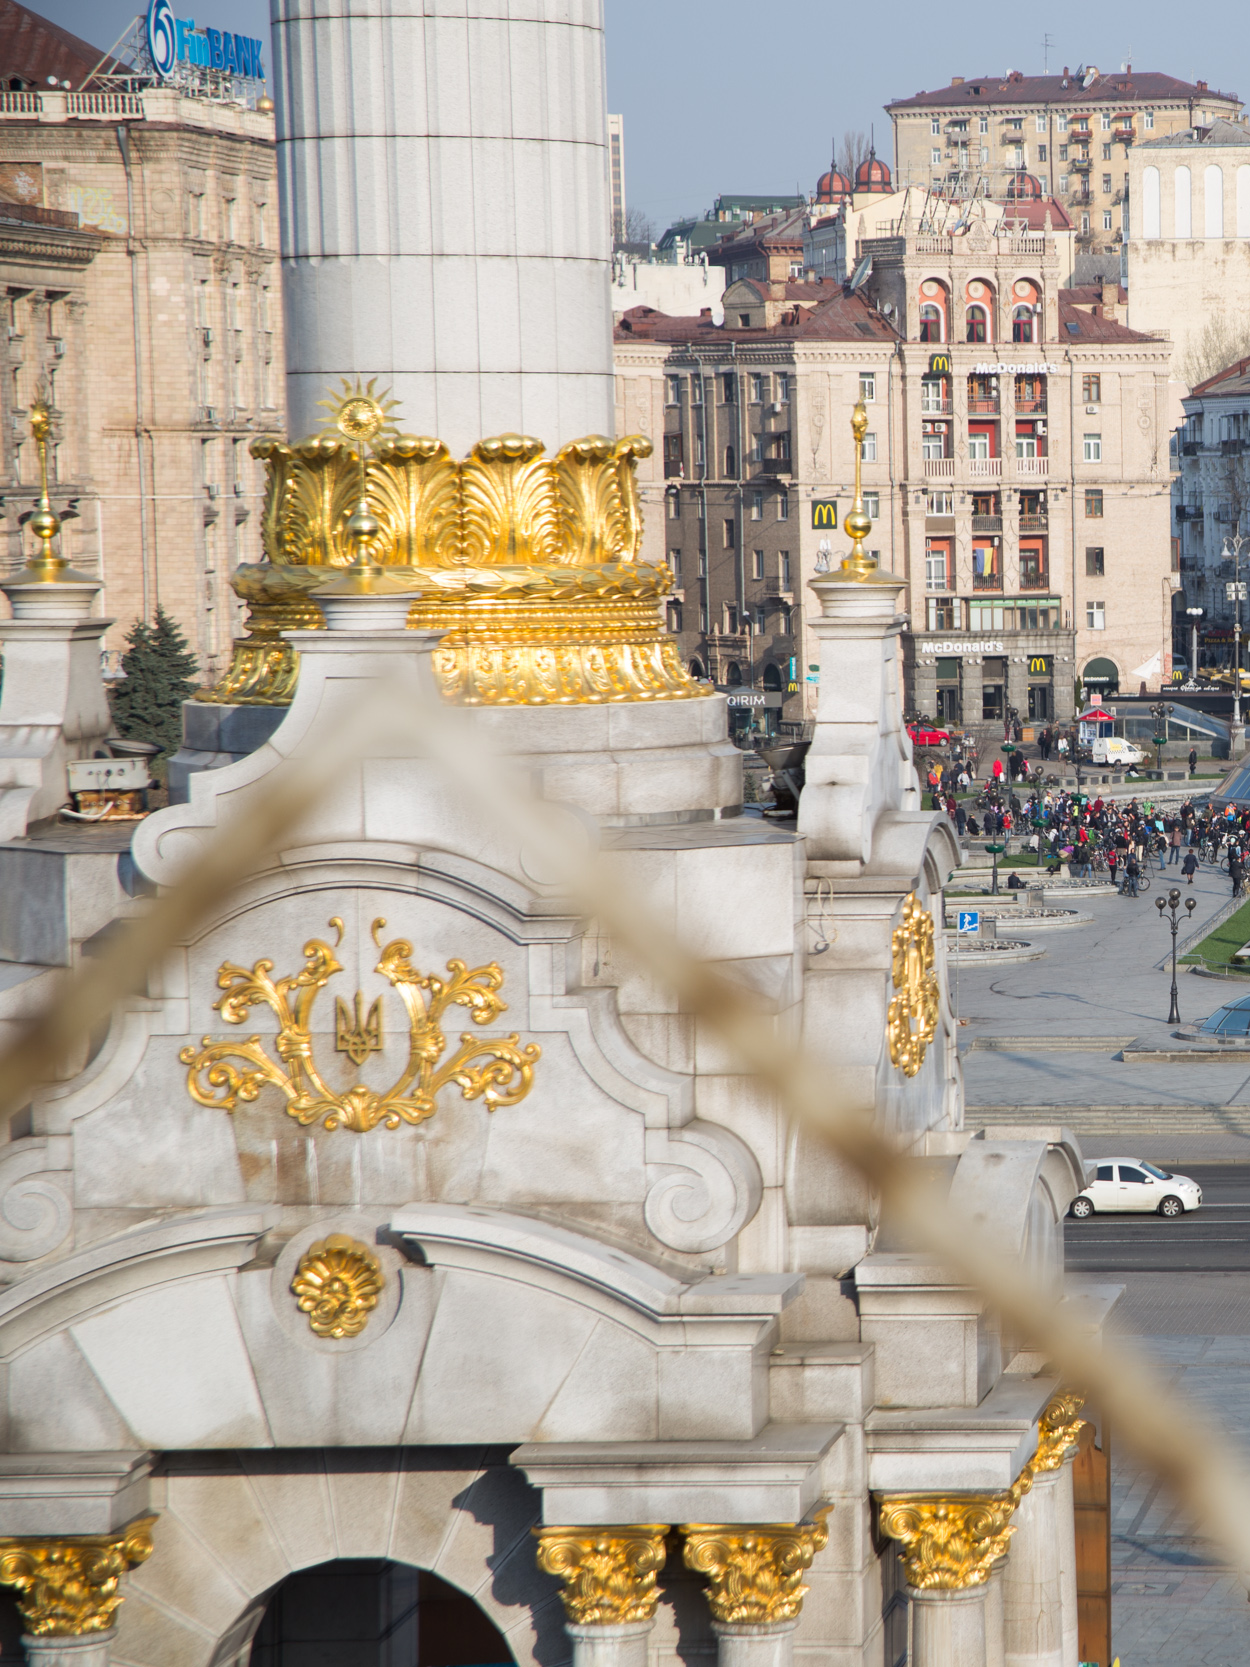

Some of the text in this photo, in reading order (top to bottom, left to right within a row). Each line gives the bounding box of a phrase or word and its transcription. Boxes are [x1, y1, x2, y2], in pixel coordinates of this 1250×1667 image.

[175, 17, 266, 79] FinBANK
[975, 362, 1058, 375] McDonald's
[921, 641, 1004, 654] McDonald's
